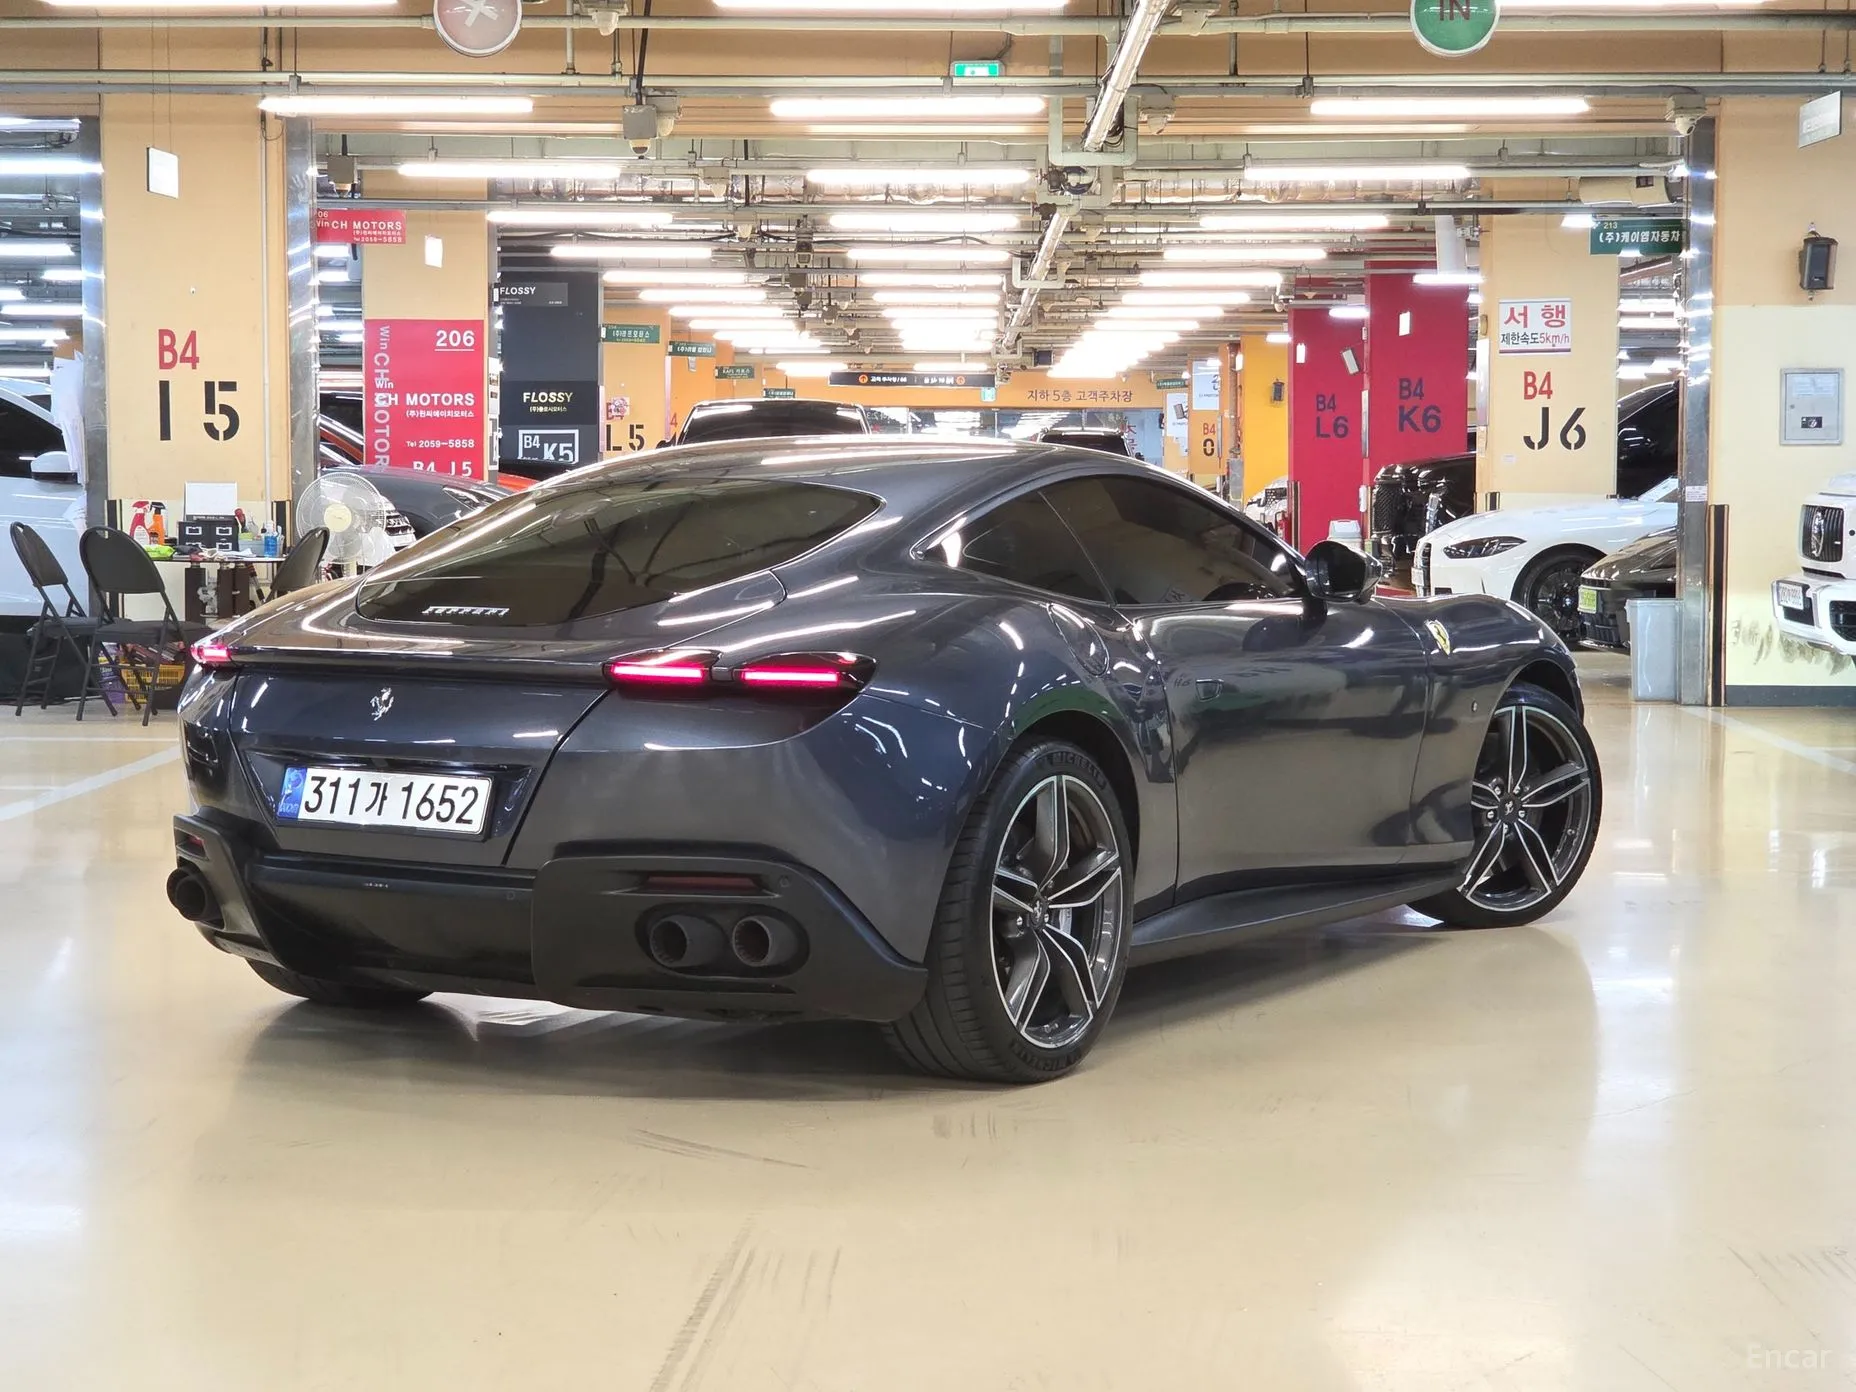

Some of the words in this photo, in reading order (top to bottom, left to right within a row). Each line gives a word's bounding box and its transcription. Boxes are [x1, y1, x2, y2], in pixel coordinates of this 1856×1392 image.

[1439, 0, 1471, 21] IN
[331, 221, 348, 230] CH
[353, 221, 402, 230] MOTORS
[1603, 222, 1618, 230] 213
[500, 286, 536, 295] FLOSSY
[436, 330, 475, 347] 206
[158, 328, 200, 370] B4
[374, 378, 394, 389] Win
[1398, 377, 1425, 400] B4
[1523, 371, 1553, 400] B4
[405, 393, 475, 406] MOTORS
[523, 392, 573, 403] FLOSSY
[1027, 389, 1049, 401] 지하
[1052, 389, 1073, 402] 5층
[1075, 389, 1133, 402] 고객주차장
[1315, 394, 1337, 412] B4
[1398, 404, 1442, 433] K6
[1203, 423, 1216, 435] B4
[1315, 415, 1349, 438] L6
[418, 439, 475, 448] 2059-5858
[523, 435, 541, 449] B4
[543, 443, 574, 463] K5
[421, 606, 510, 617] Ferrari
[303, 776, 388, 817] 311가
[401, 781, 479, 825] 1652
